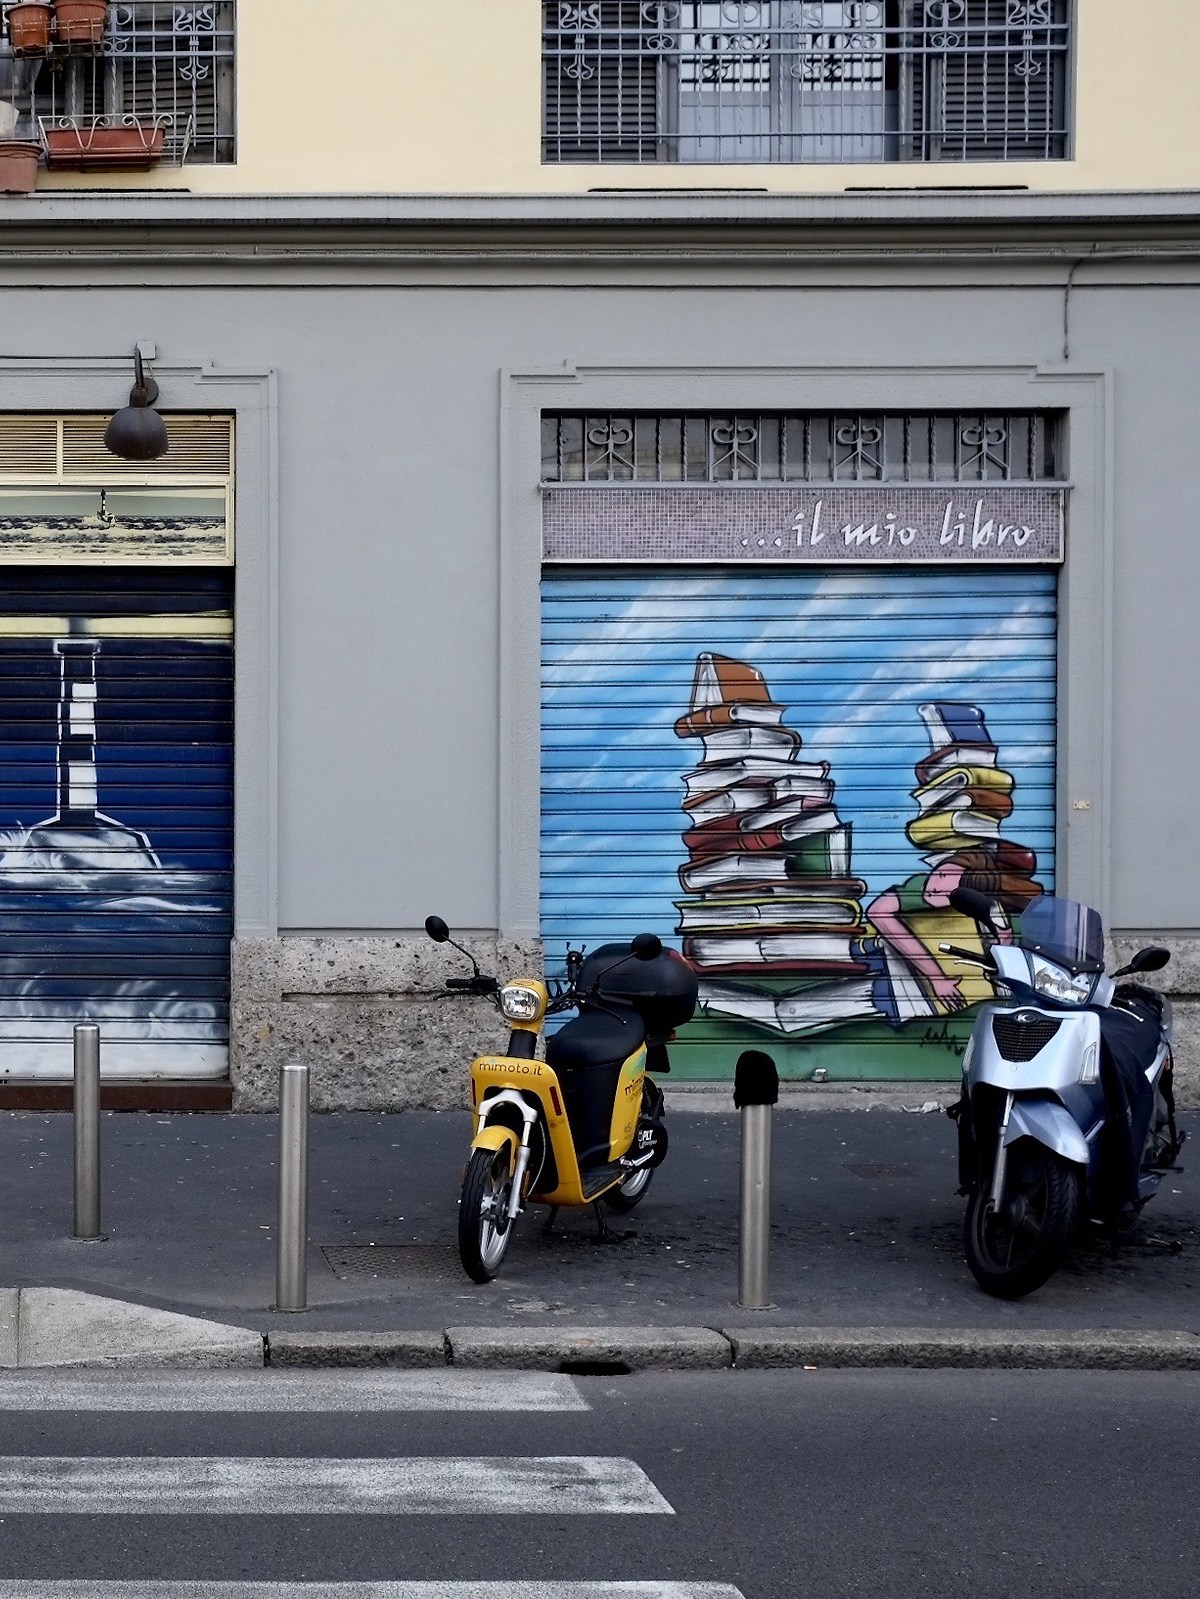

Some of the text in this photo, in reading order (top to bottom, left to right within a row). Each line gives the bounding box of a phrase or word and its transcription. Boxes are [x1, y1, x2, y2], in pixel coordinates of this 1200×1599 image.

[840, 512, 918, 546] mio
[939, 498, 1036, 550] libro
[479, 1063, 542, 1076] mimoto.it
